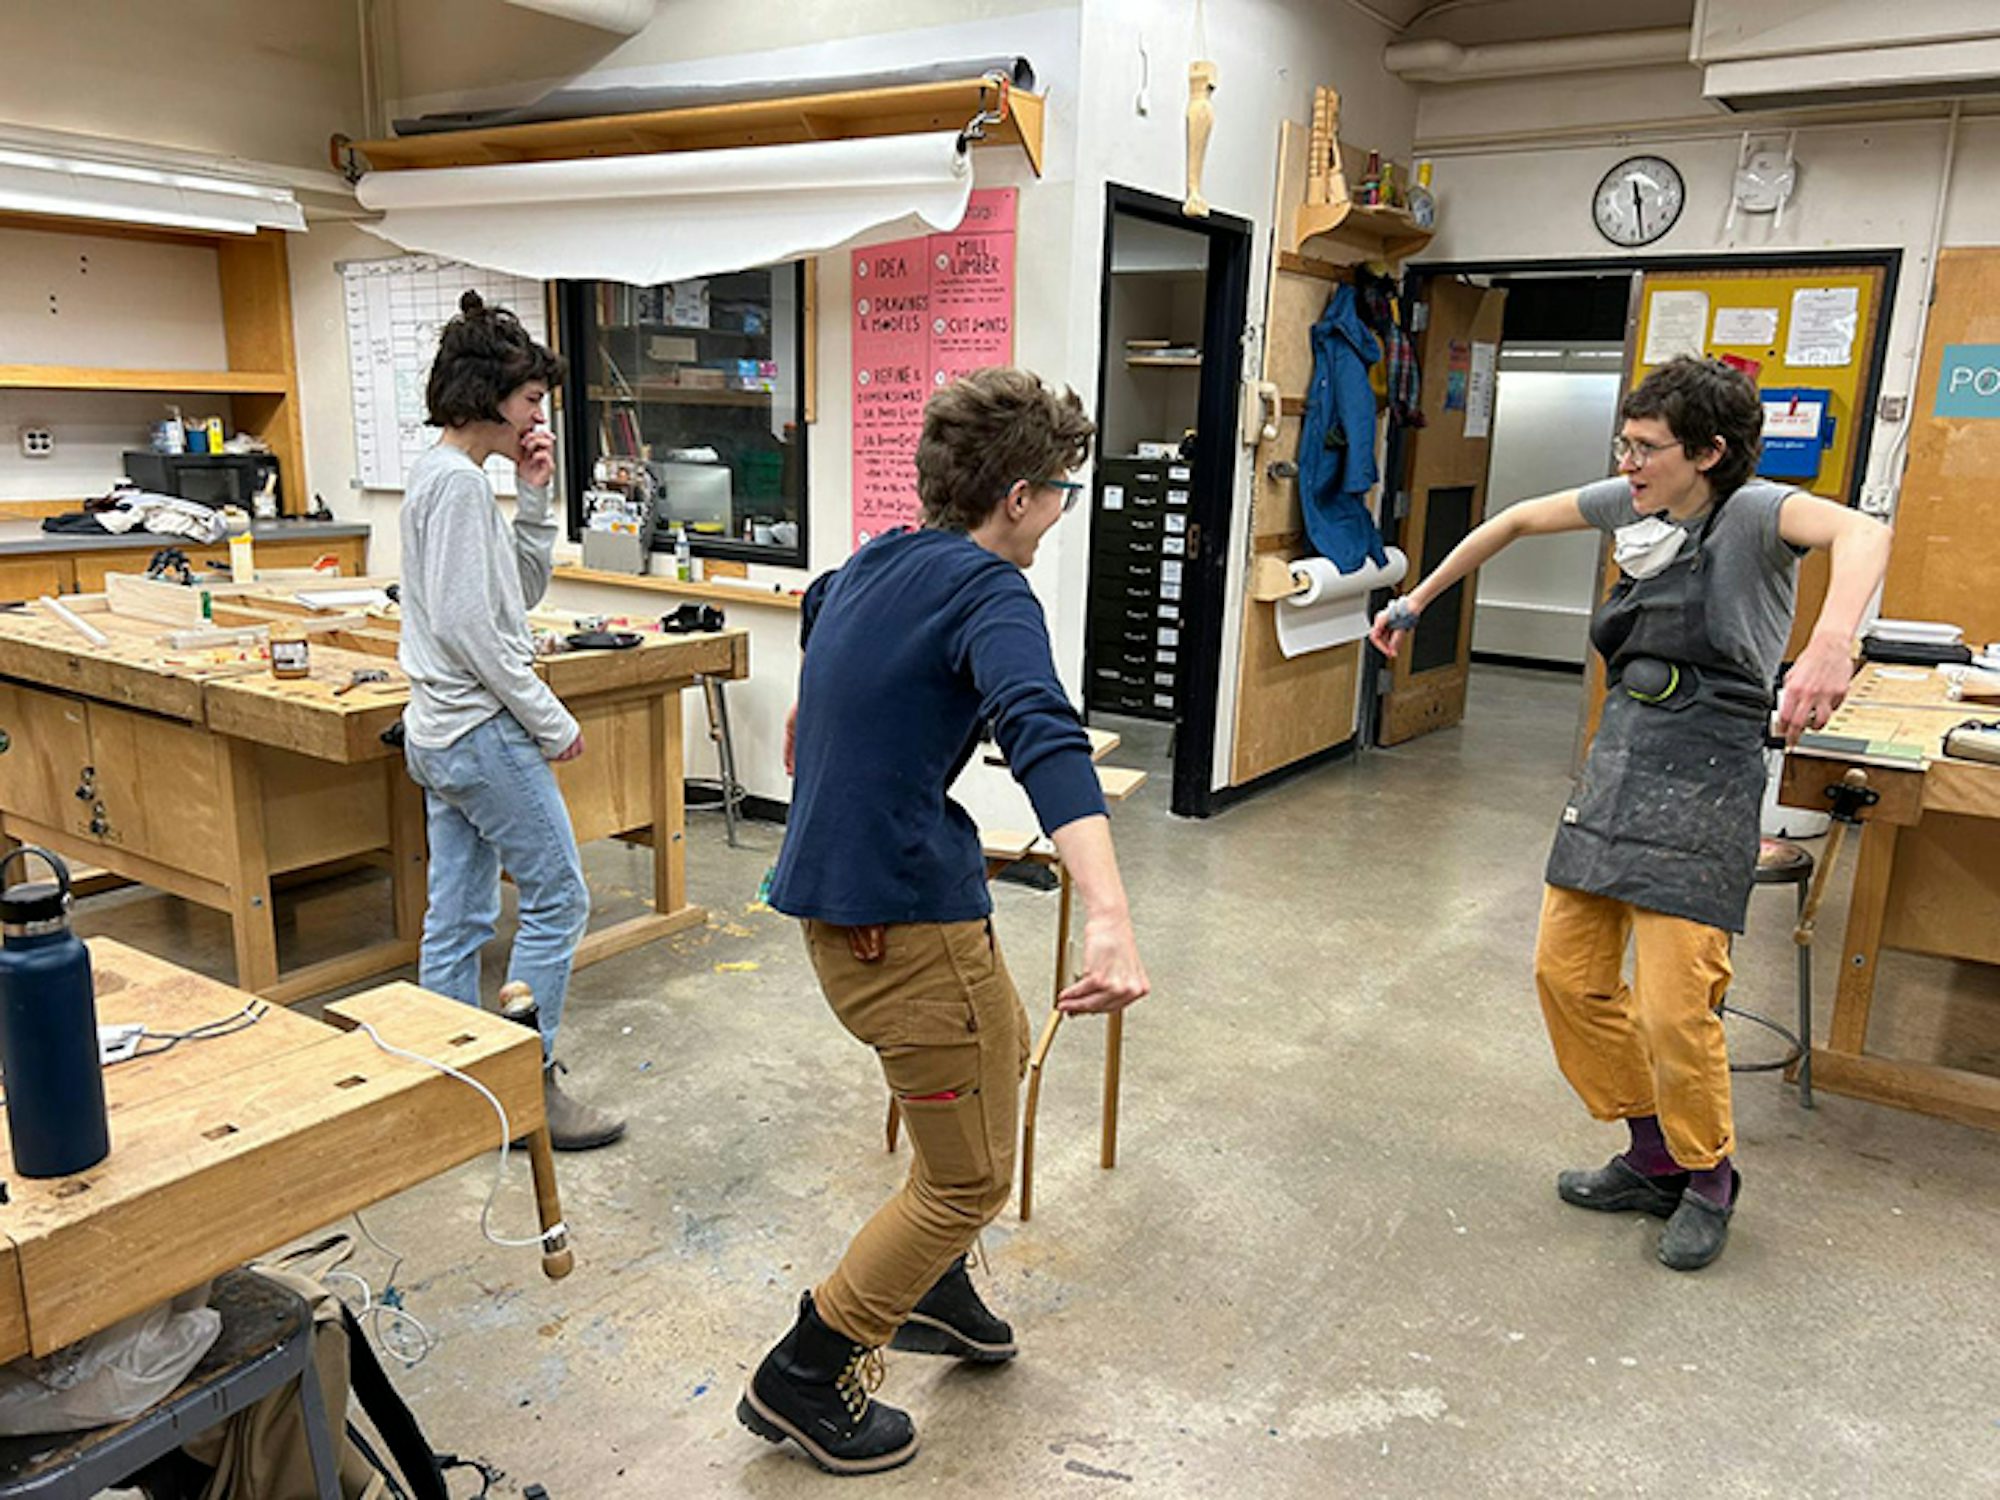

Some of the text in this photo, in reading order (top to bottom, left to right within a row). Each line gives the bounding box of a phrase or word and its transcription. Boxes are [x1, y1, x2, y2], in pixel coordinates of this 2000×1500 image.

[956, 240, 987, 256] MILL
[875, 257, 906, 278] IDEA
[951, 254, 1000, 275] LUMBER
[875, 296, 929, 312] DRAWINGS
[872, 315, 920, 333] MODELS
[949, 318, 969, 333] CUT
[1949, 366, 2000, 396] PO
